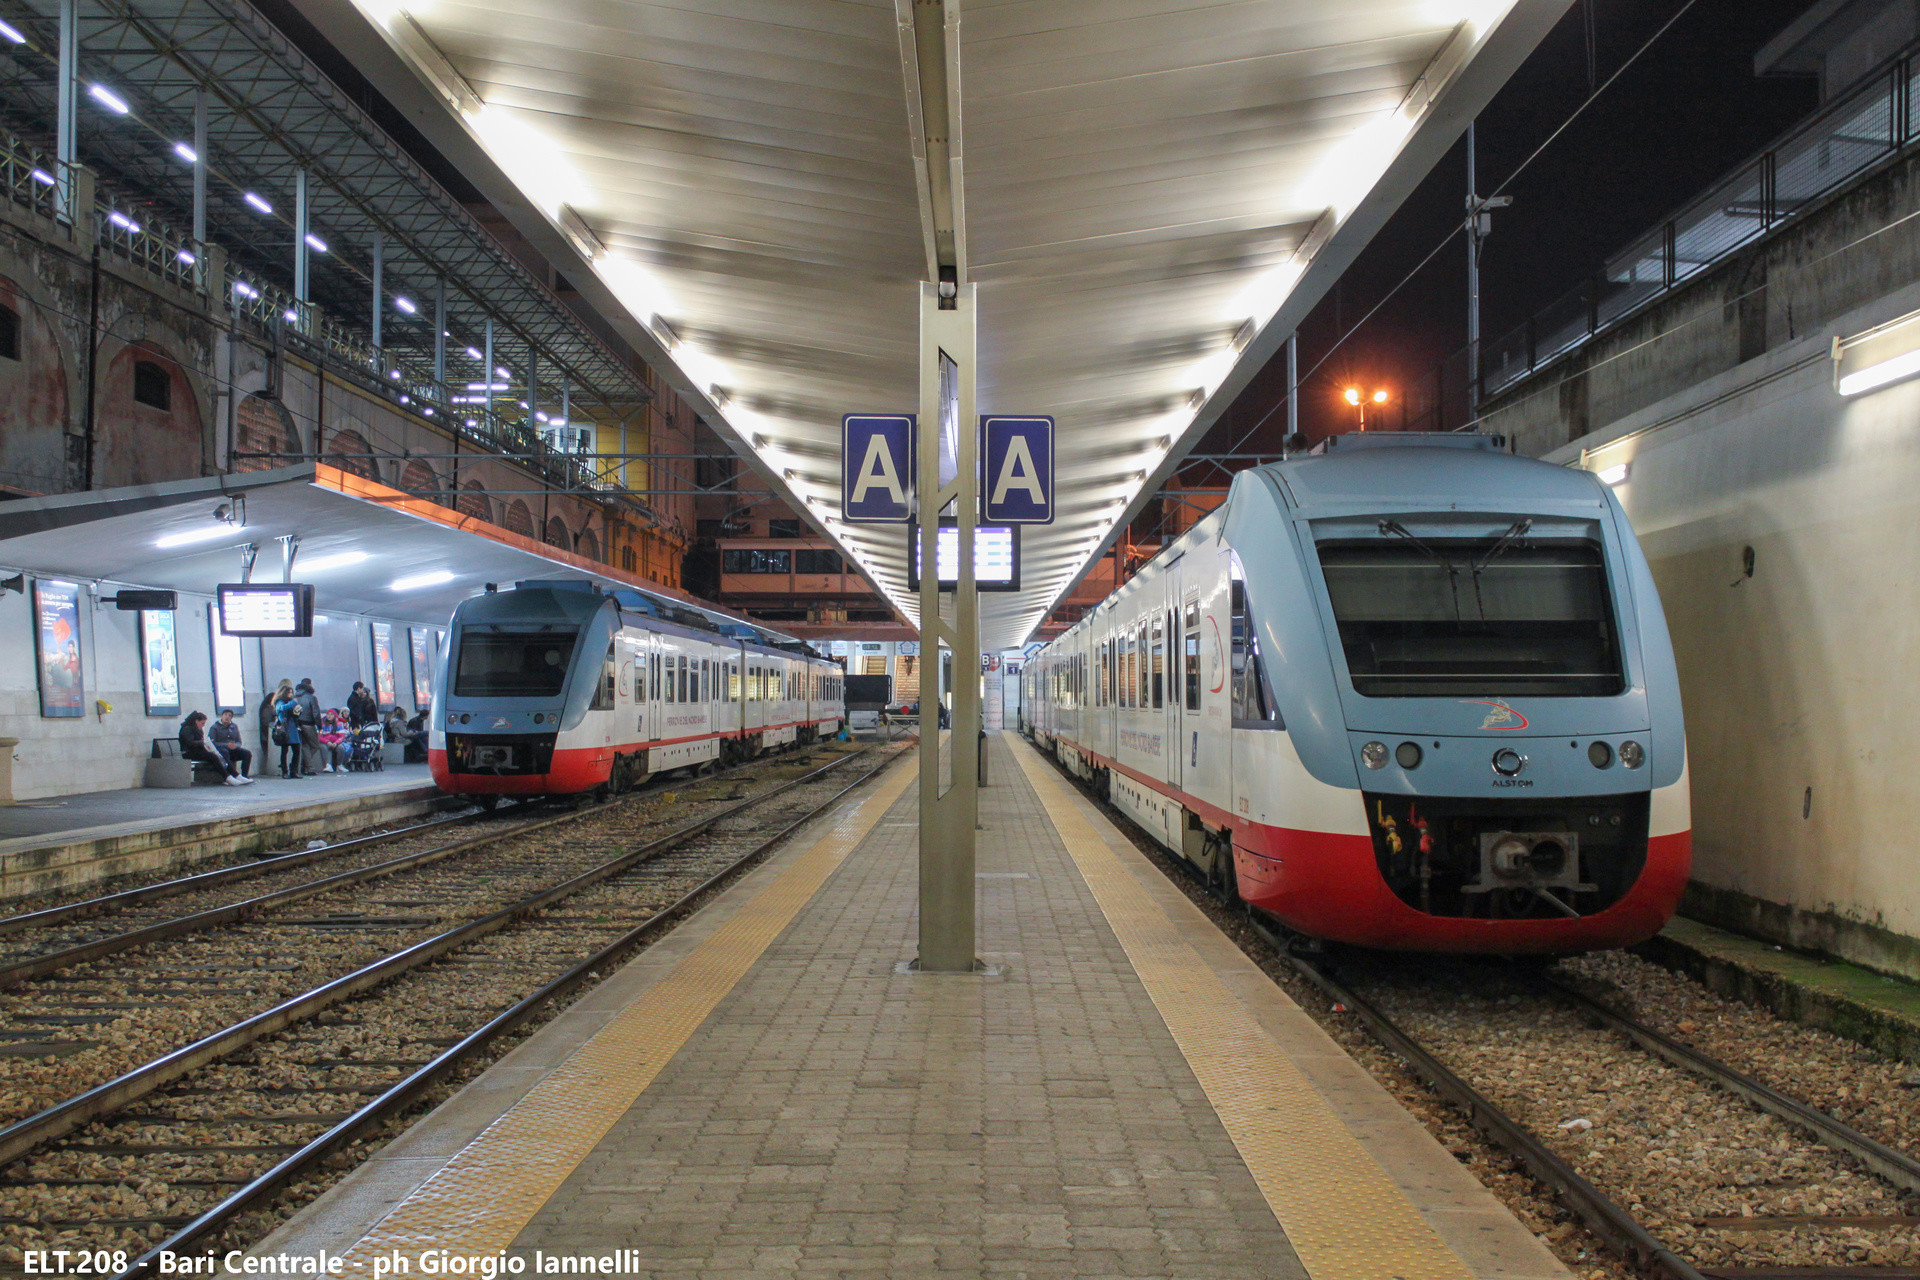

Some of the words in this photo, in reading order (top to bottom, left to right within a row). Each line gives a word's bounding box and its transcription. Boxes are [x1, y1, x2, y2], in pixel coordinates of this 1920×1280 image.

[851, 434, 906, 503] A
[991, 435, 1046, 504] A
[982, 655, 989, 666] B
[1492, 779, 1534, 788] ALSTOM
